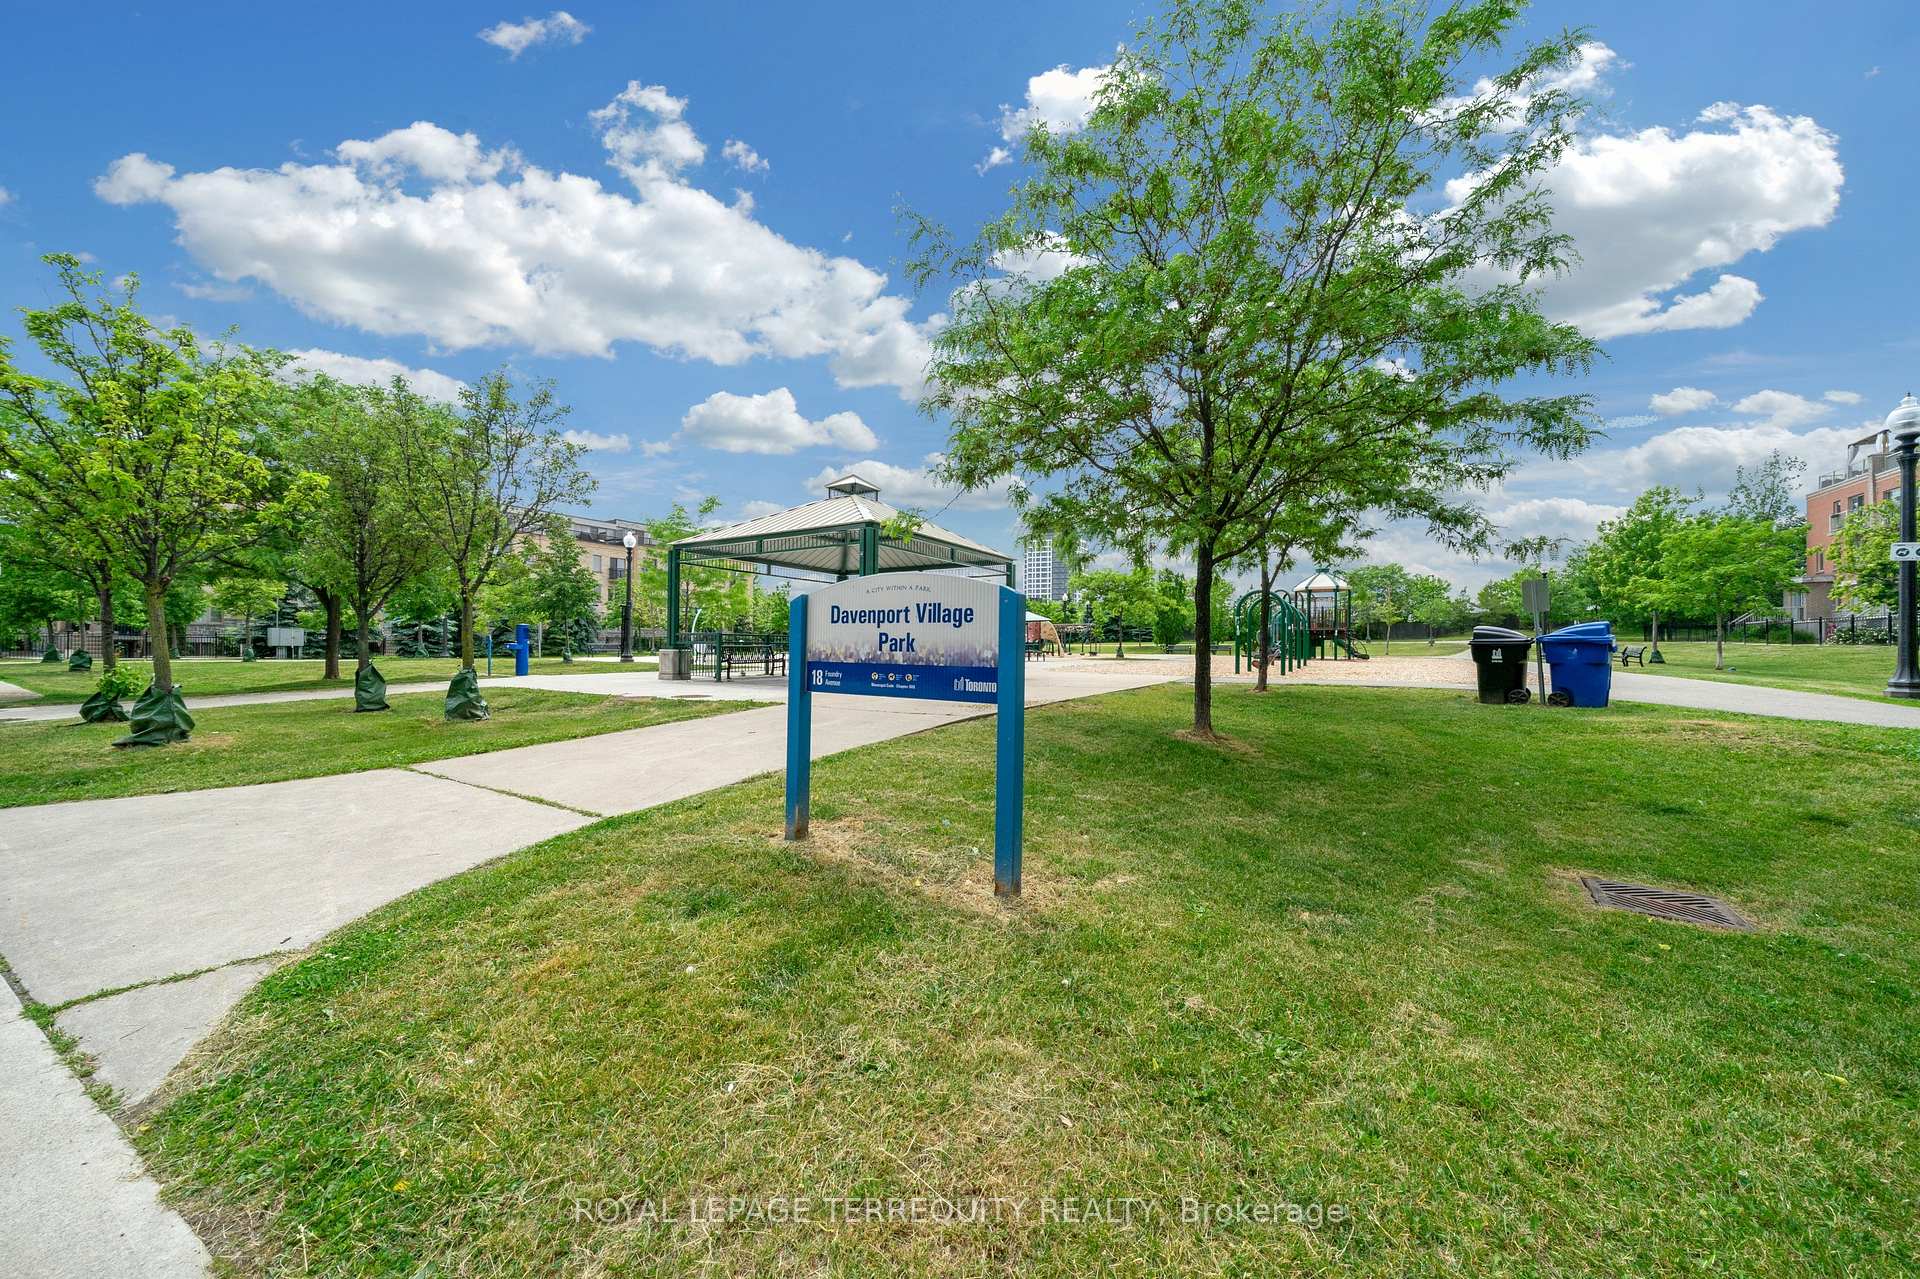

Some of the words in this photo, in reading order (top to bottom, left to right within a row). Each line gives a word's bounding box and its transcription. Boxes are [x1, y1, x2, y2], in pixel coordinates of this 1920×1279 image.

[831, 604, 910, 628] Davenport
[917, 602, 974, 628] Village
[878, 632, 915, 652] Park
[811, 669, 823, 686] 18
